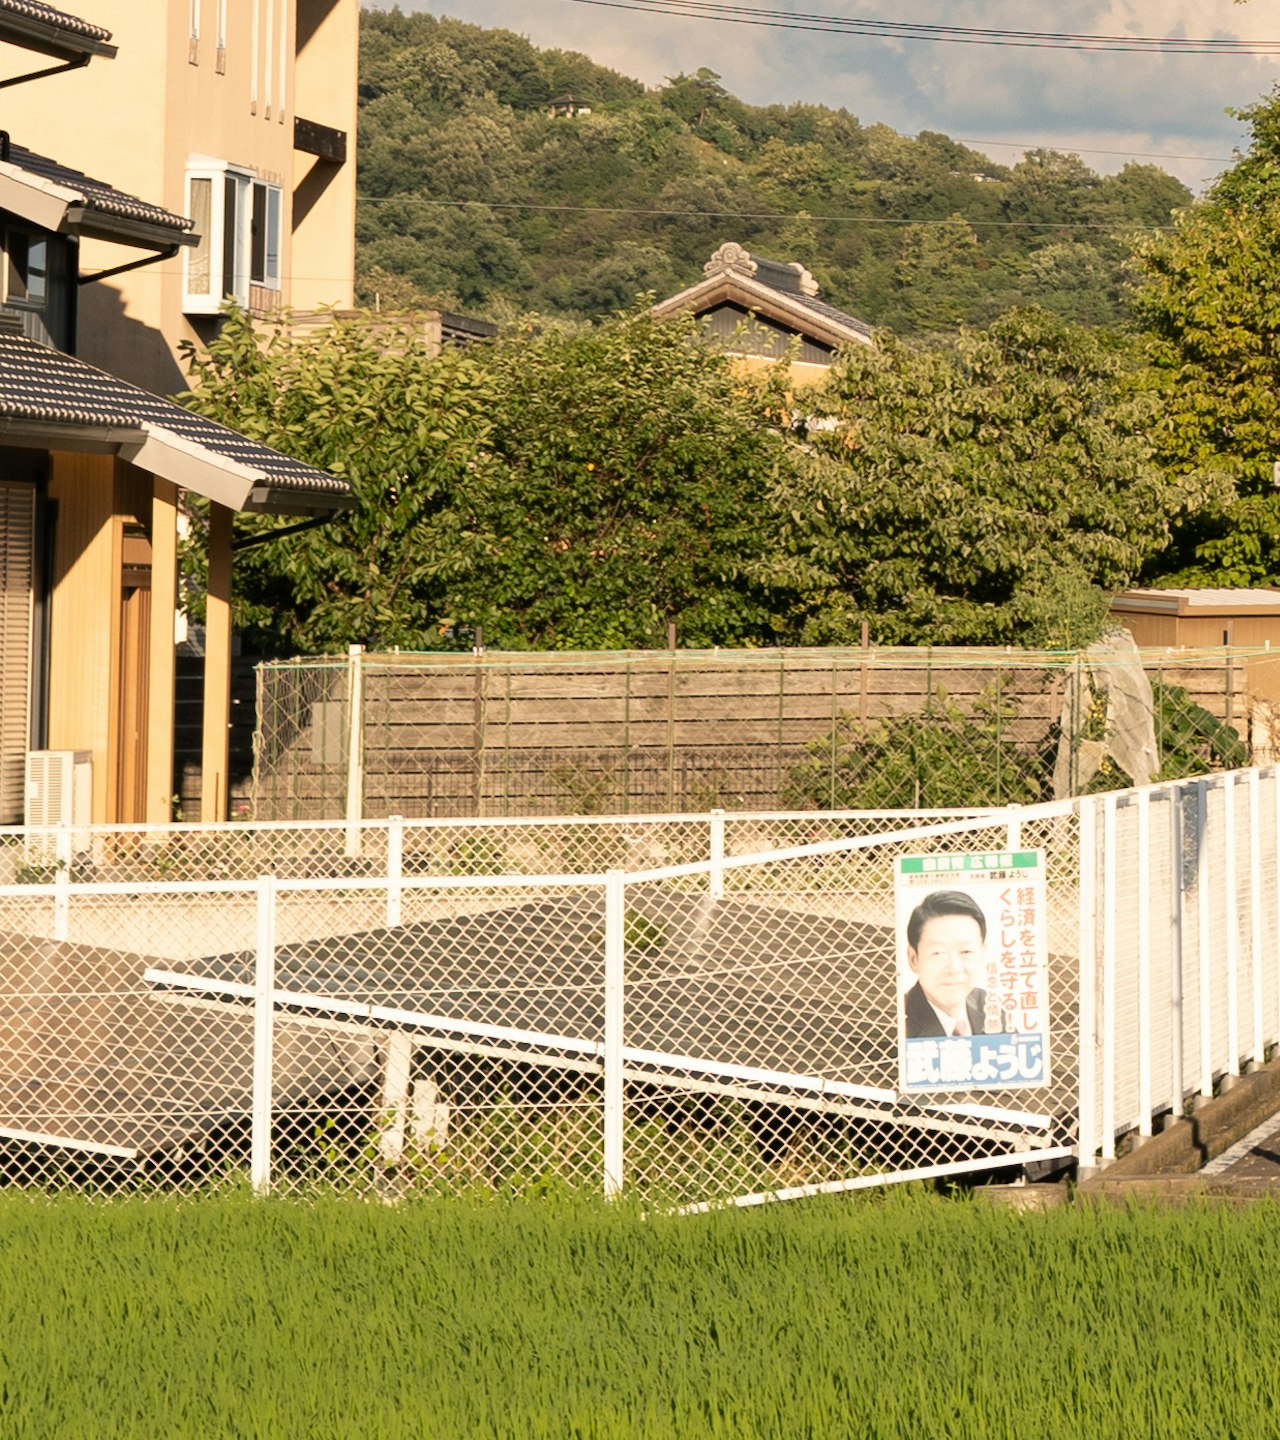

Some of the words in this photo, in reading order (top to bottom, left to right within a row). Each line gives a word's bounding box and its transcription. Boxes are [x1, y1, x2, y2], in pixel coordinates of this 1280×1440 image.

[1017, 887, 1038, 1030] 経済を立て直し
[906, 1038, 1043, 1084] 武藤ようじ
